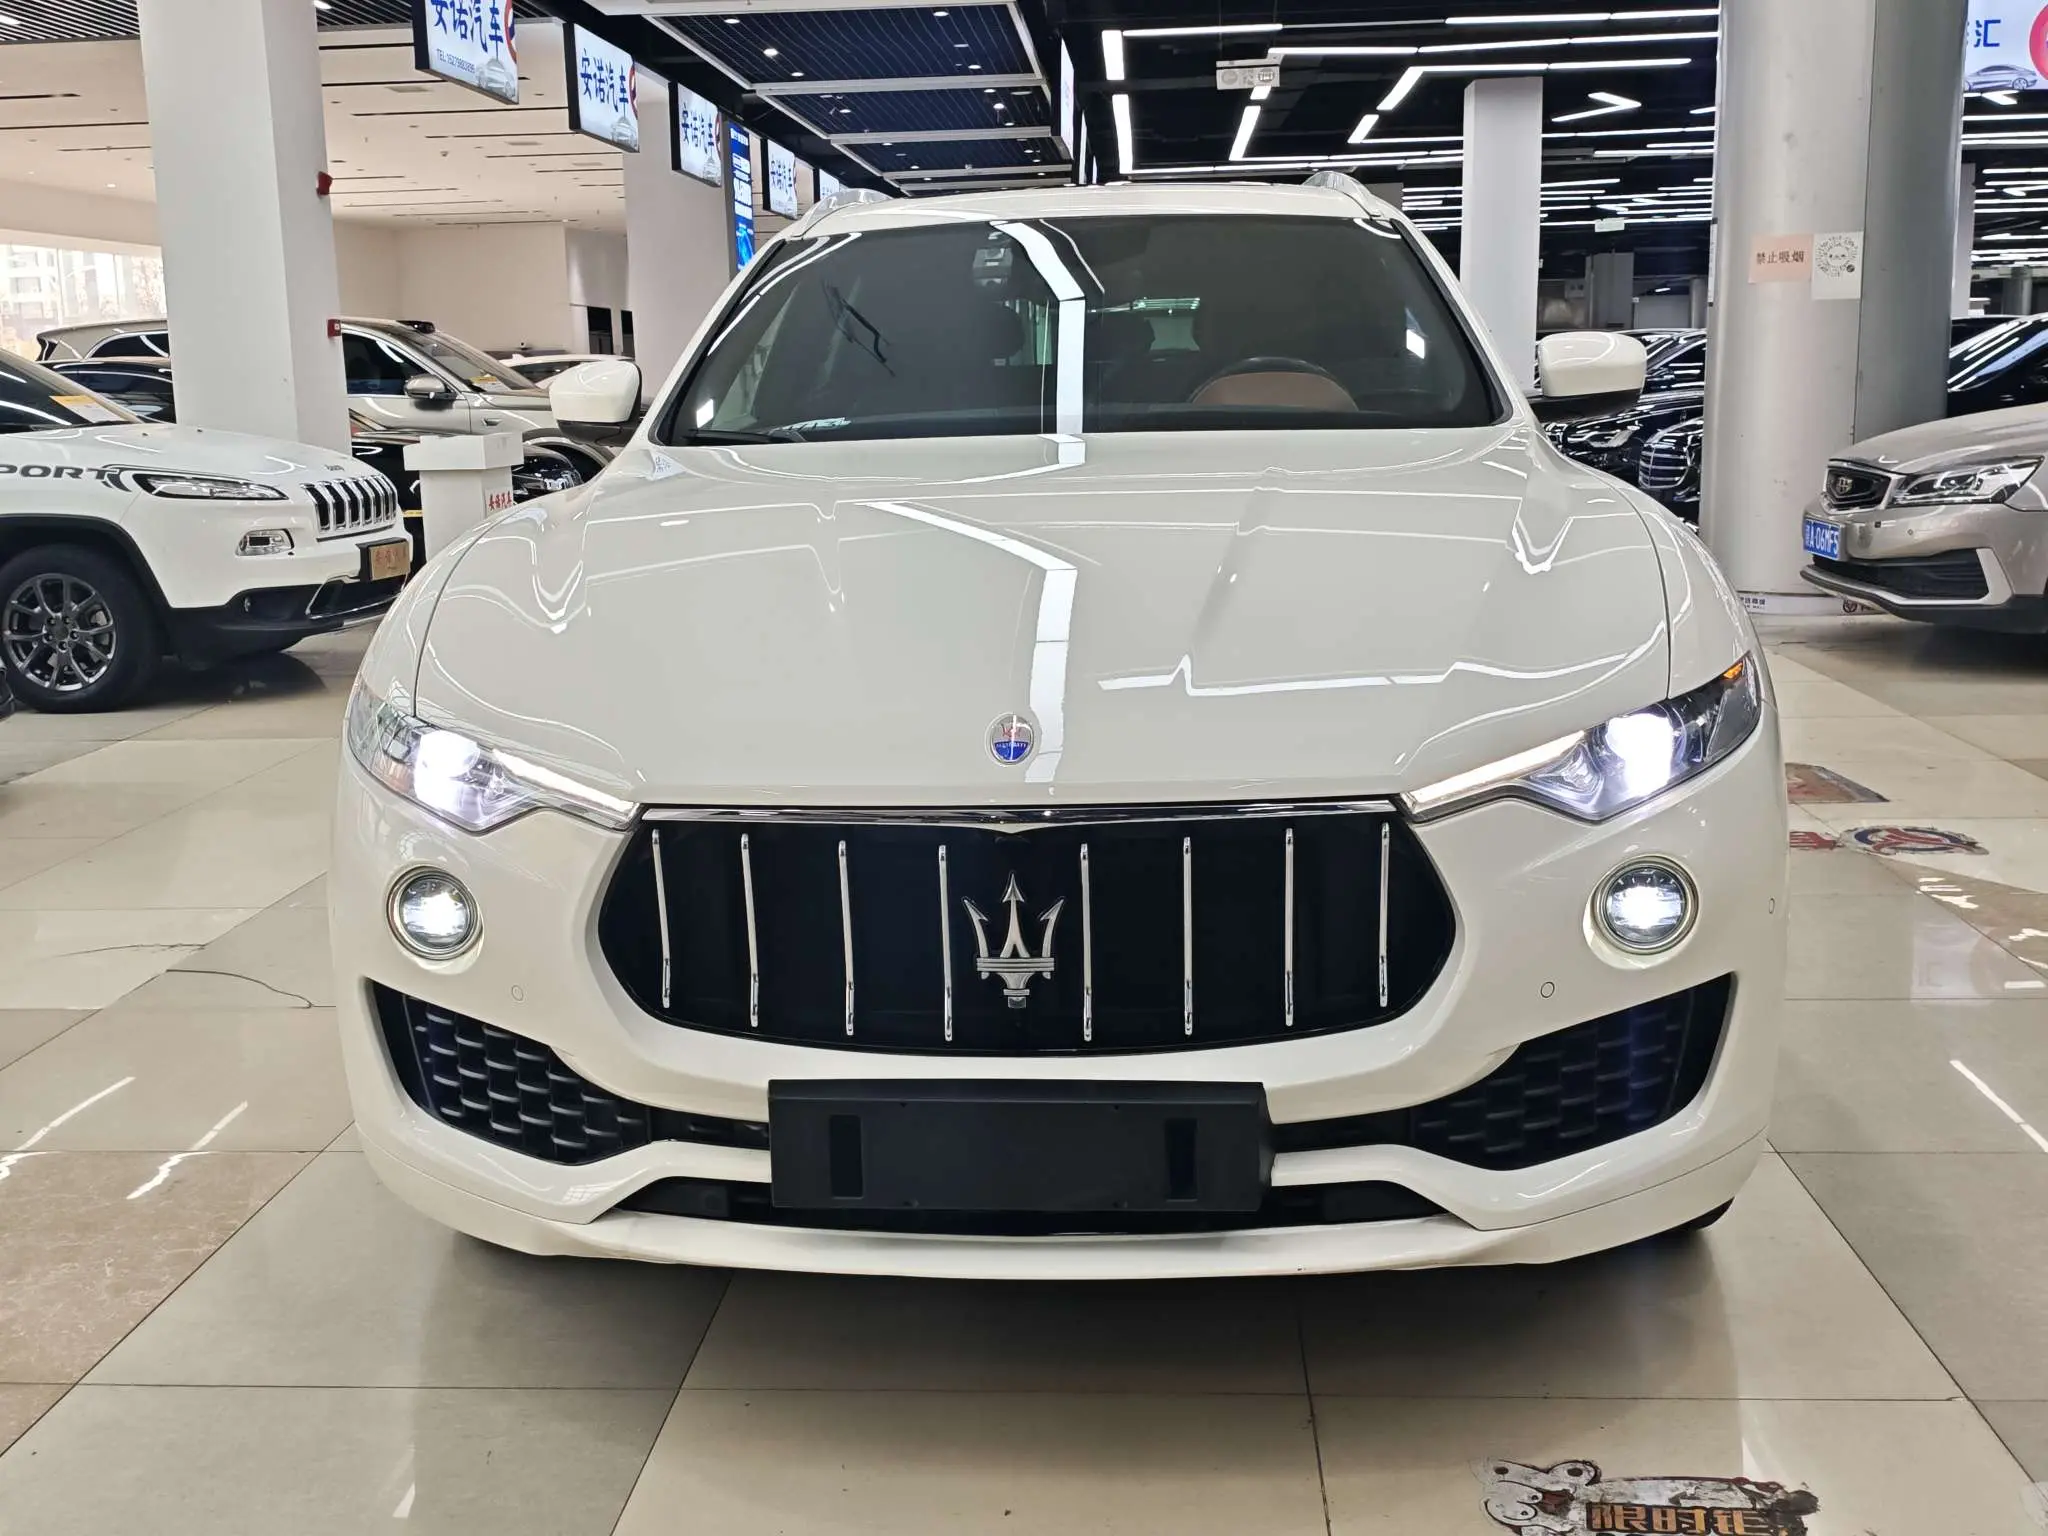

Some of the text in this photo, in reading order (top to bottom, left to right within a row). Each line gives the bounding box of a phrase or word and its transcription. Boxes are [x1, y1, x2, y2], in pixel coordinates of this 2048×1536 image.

[1966, 19, 2002, 48] 汇
[580, 48, 629, 118] 安诺汽车
[1756, 250, 1805, 265] 禁止吸烟
